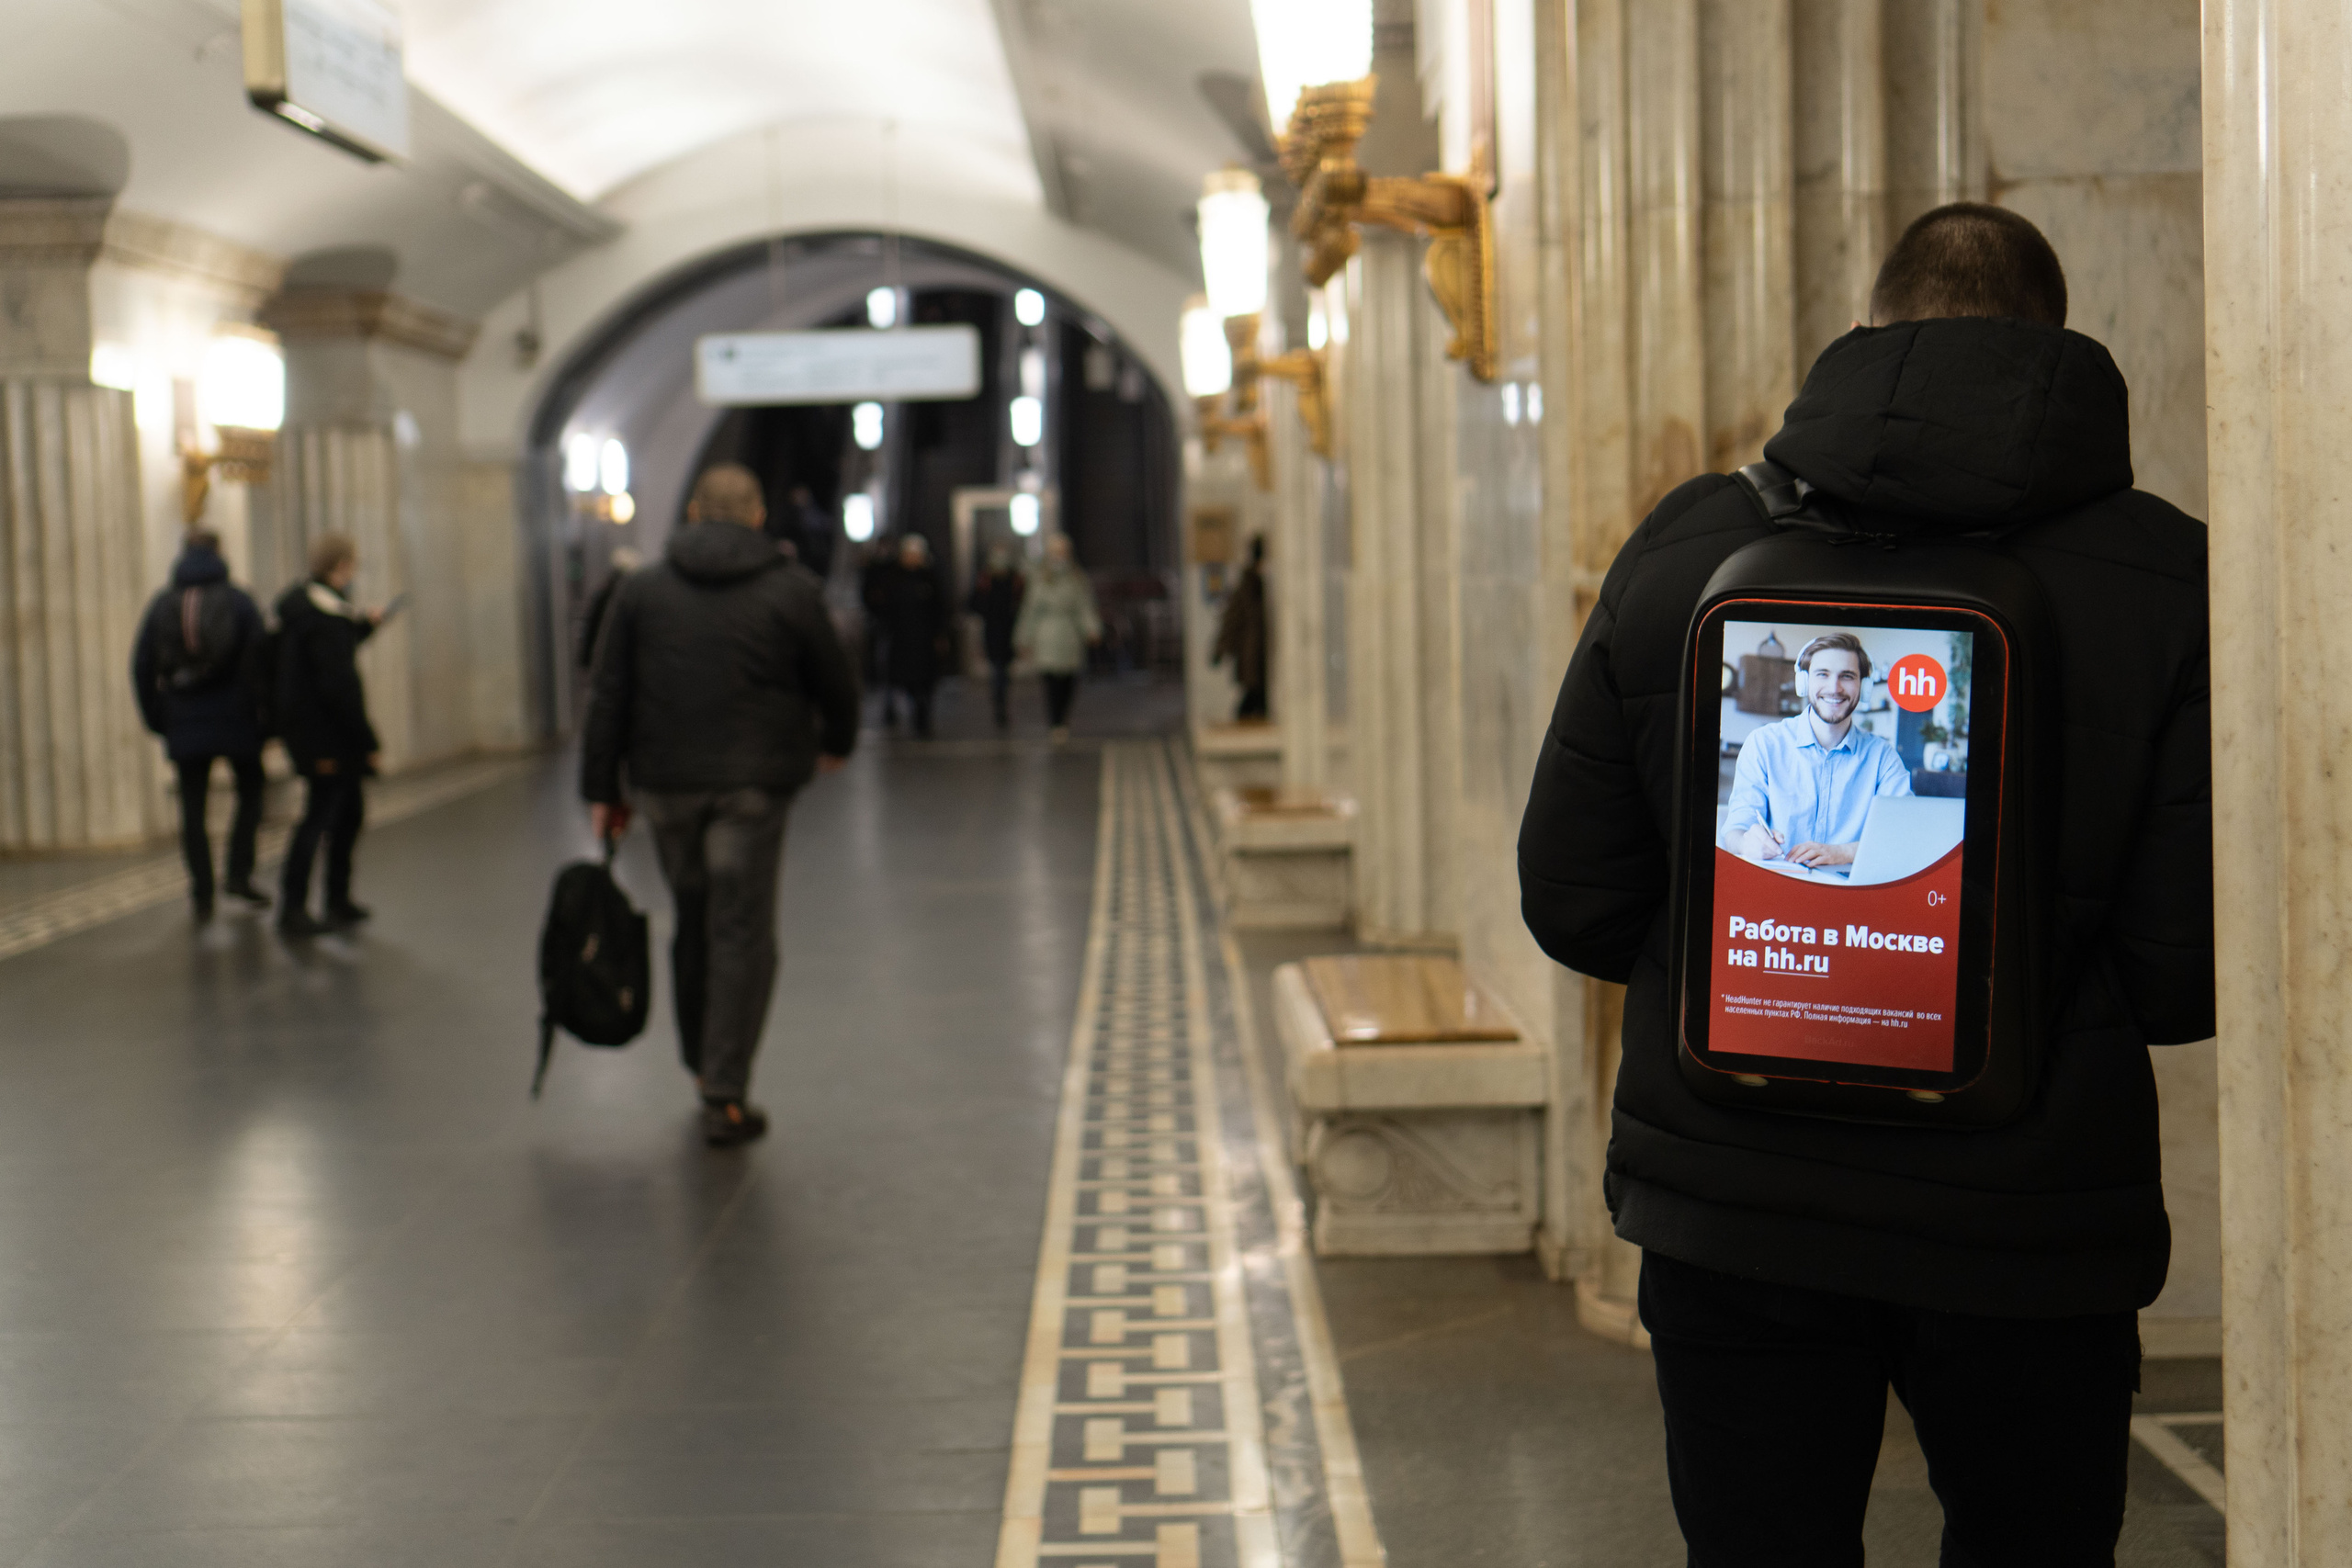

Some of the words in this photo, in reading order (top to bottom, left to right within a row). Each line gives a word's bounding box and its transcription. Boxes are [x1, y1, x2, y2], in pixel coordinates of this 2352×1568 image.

[1898, 667, 1936, 696] hh
[1928, 890, 1947, 907] 0+
[1729, 916, 1816, 943] Работа
[1823, 929, 1838, 946] в
[1845, 924, 1945, 954] Москве
[1727, 948, 1758, 967] на
[1764, 946, 1829, 974] hh.ru
[1724, 1006, 1764, 1016] населенных
[1764, 1009, 1790, 1019] пунктах
[1790, 1010, 1803, 1019] РФ.
[1804, 1010, 1828, 1021] Полная
[1828, 1014, 1871, 1025] информация
[1890, 1019, 1908, 1029] hh.ru
[1763, 998, 1771, 1007] не
[1772, 999, 1812, 1010] гарантирует
[1813, 1003, 1840, 1012] наличие
[1841, 1006, 1882, 1016] подходящих
[1883, 1009, 1914, 1019] вакансий
[1917, 1011, 1926, 1020] во
[1926, 1012, 1942, 1021] всех
